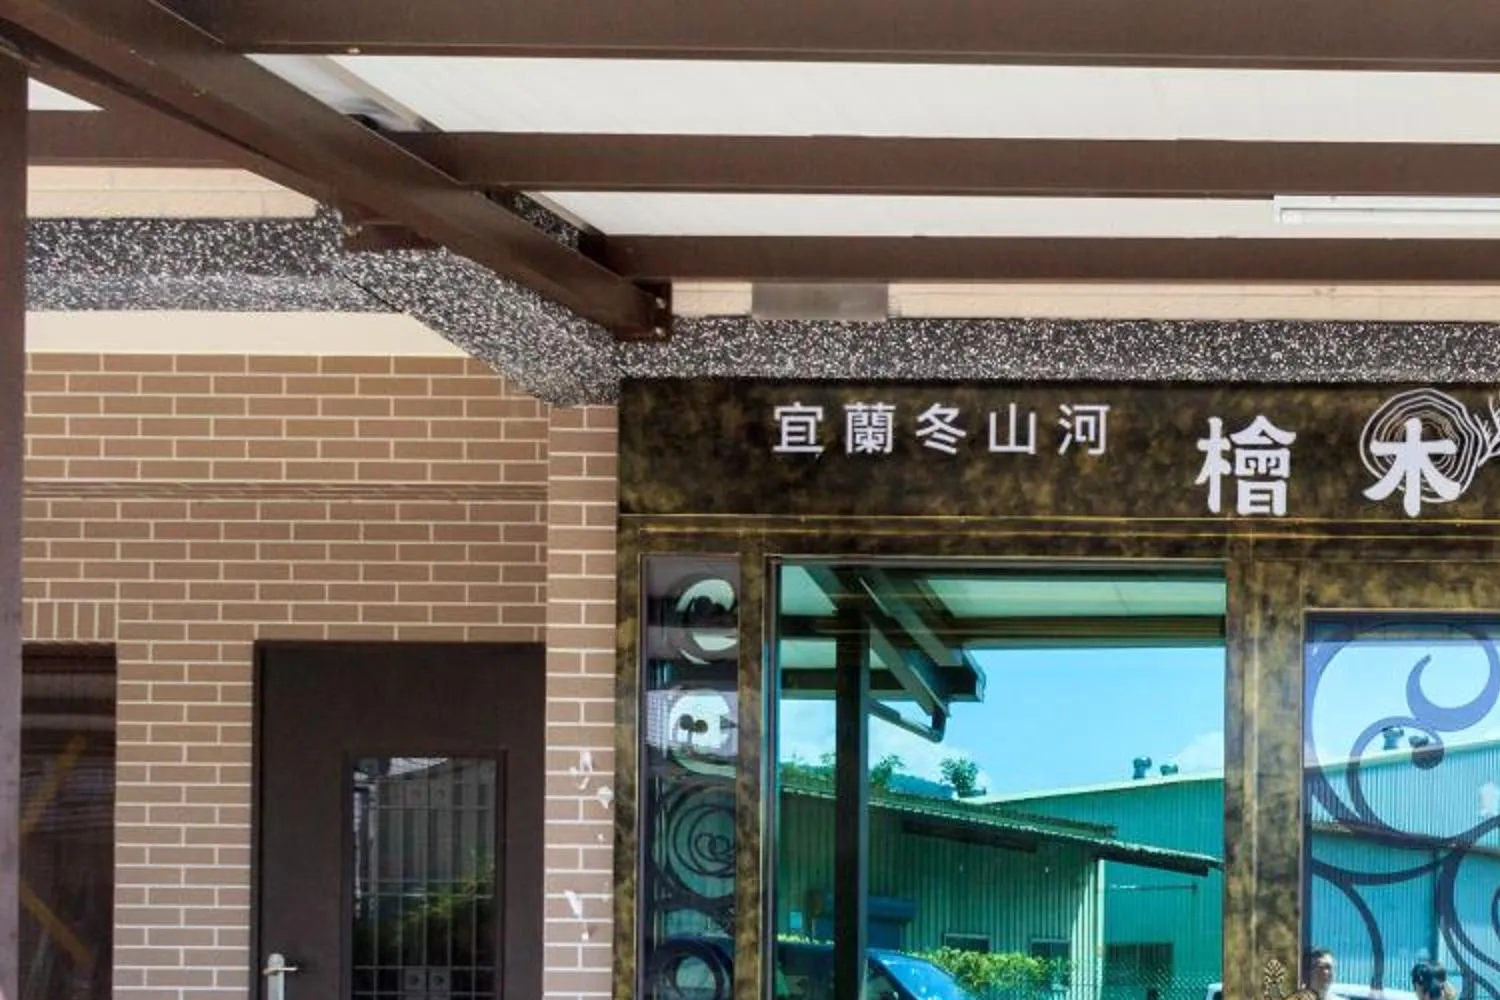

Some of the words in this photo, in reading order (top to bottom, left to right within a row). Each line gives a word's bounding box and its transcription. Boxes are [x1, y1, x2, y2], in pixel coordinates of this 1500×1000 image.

[773, 402, 1111, 455] 宜蘭冬山河
